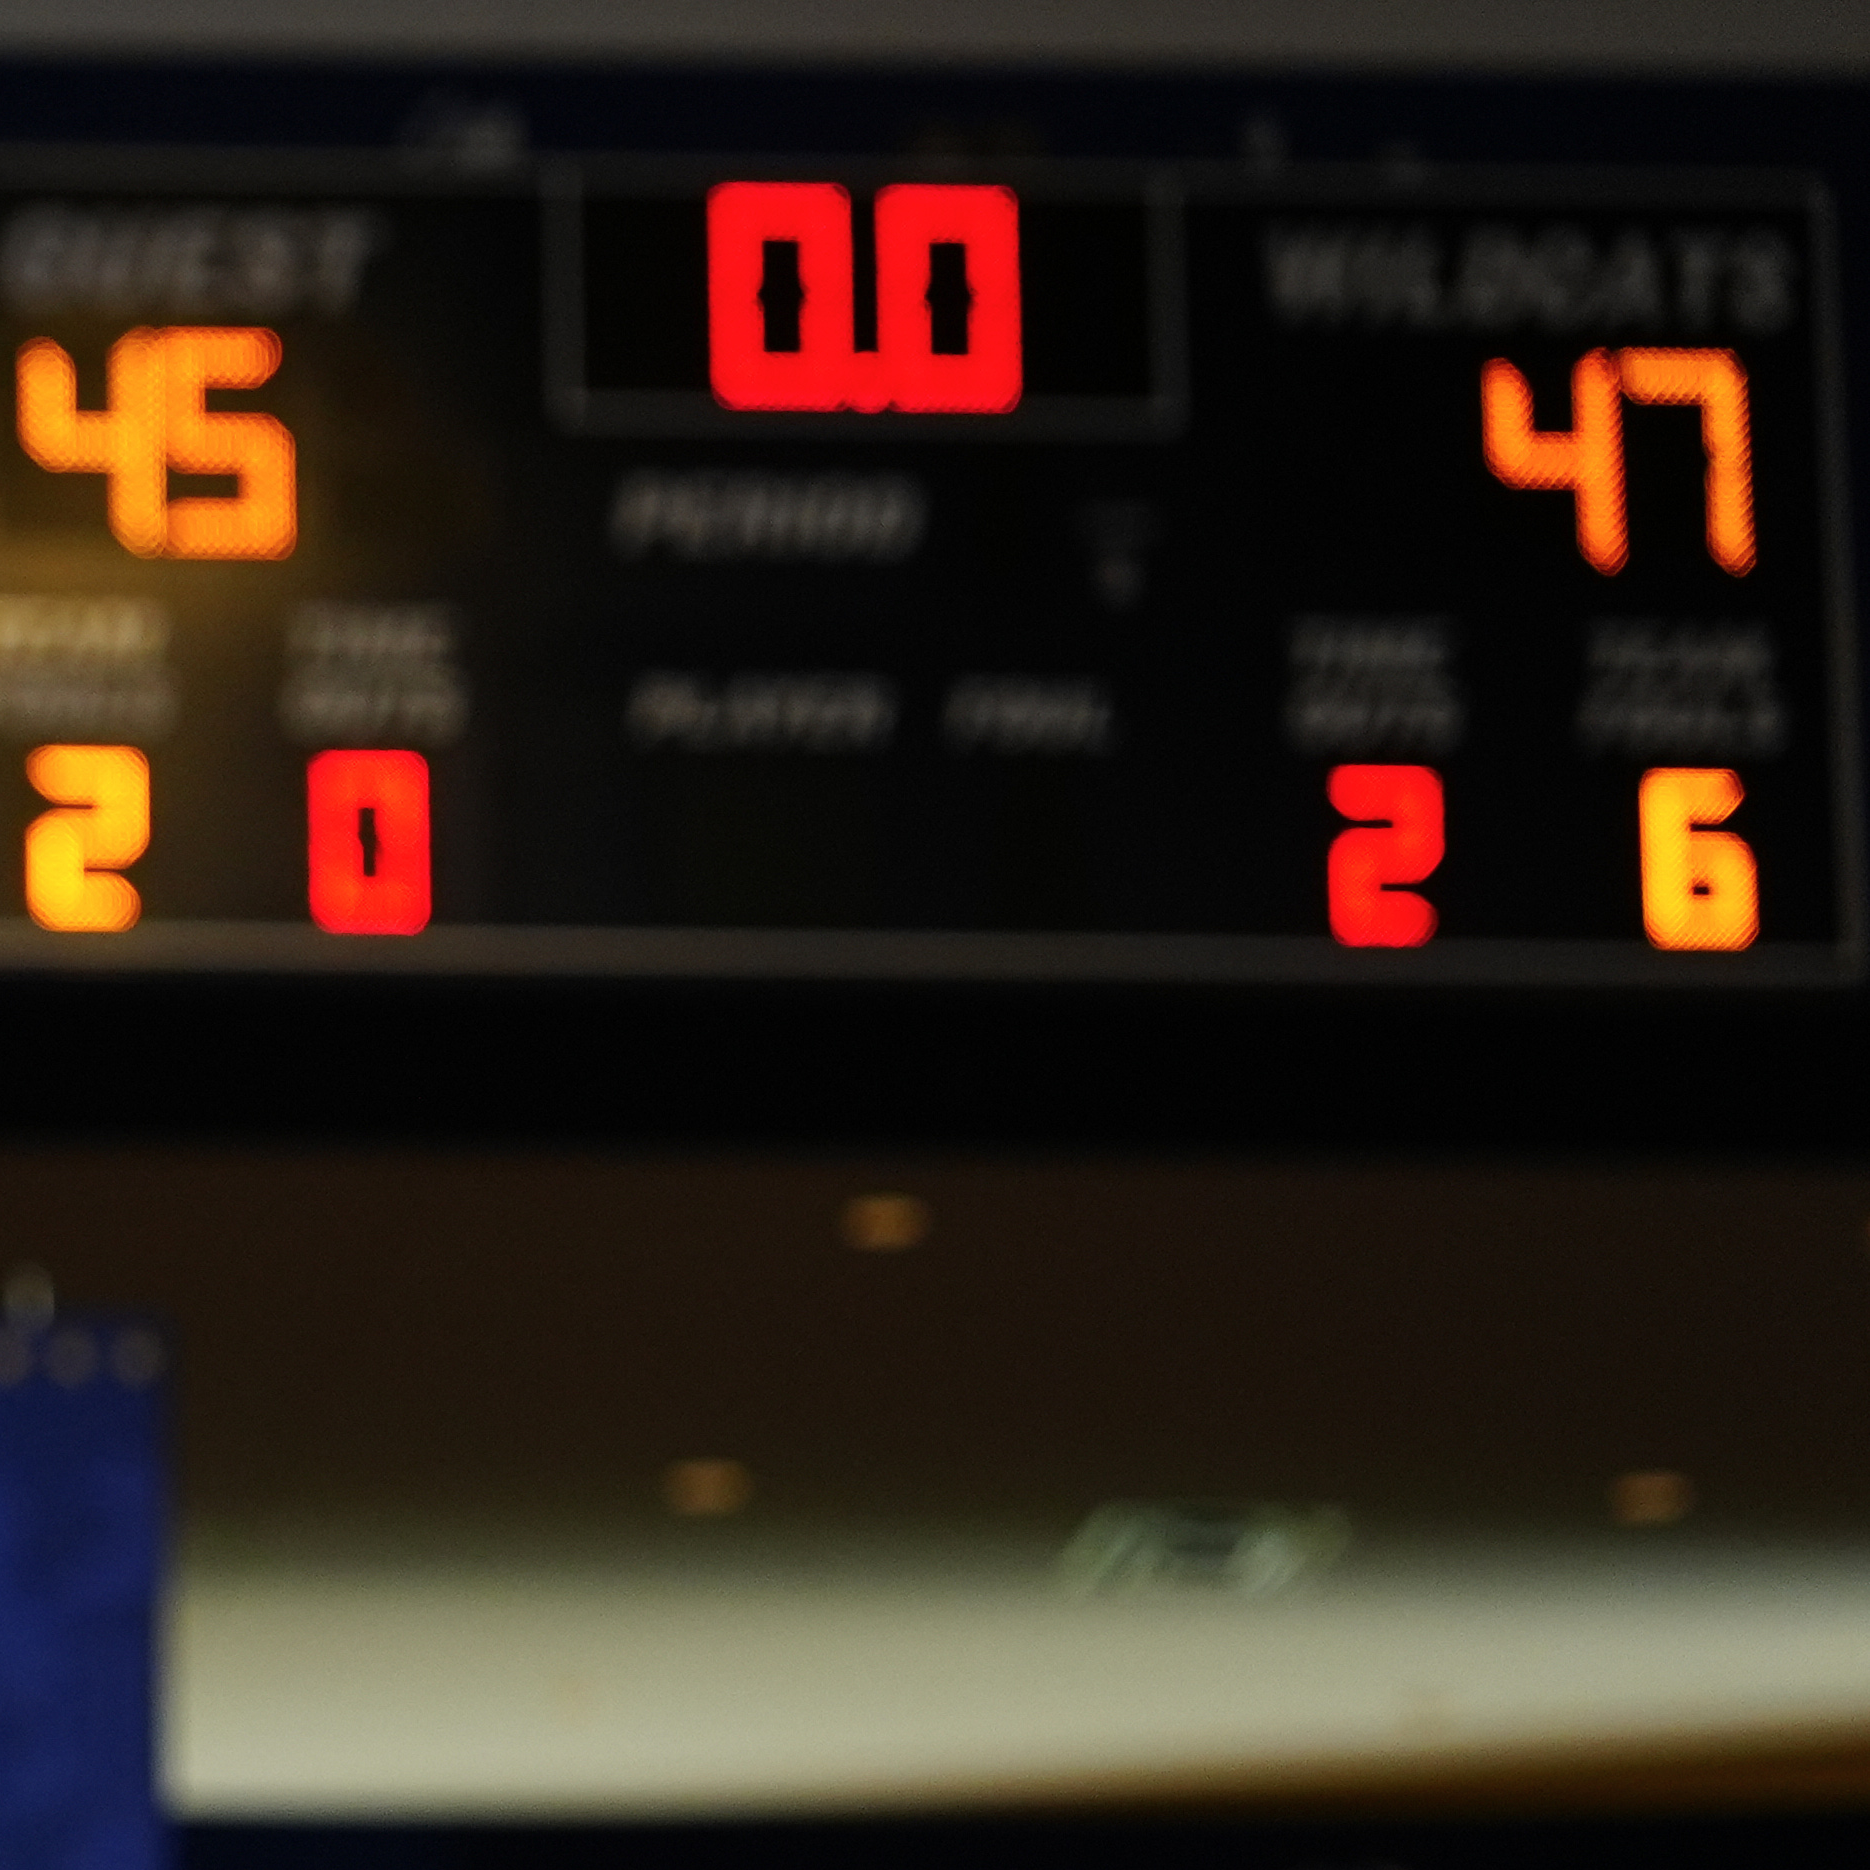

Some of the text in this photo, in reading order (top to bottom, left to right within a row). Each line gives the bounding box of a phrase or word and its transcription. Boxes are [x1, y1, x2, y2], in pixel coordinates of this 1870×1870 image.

[1264, 222, 1796, 332] WILDCATS
[15, 326, 297, 560] 45
[1481, 346, 1757, 577] 47
[26, 744, 150, 932] 2
[307, 748, 432, 935] 0
[1327, 763, 1446, 947] 2
[1639, 767, 1760, 950] 6
